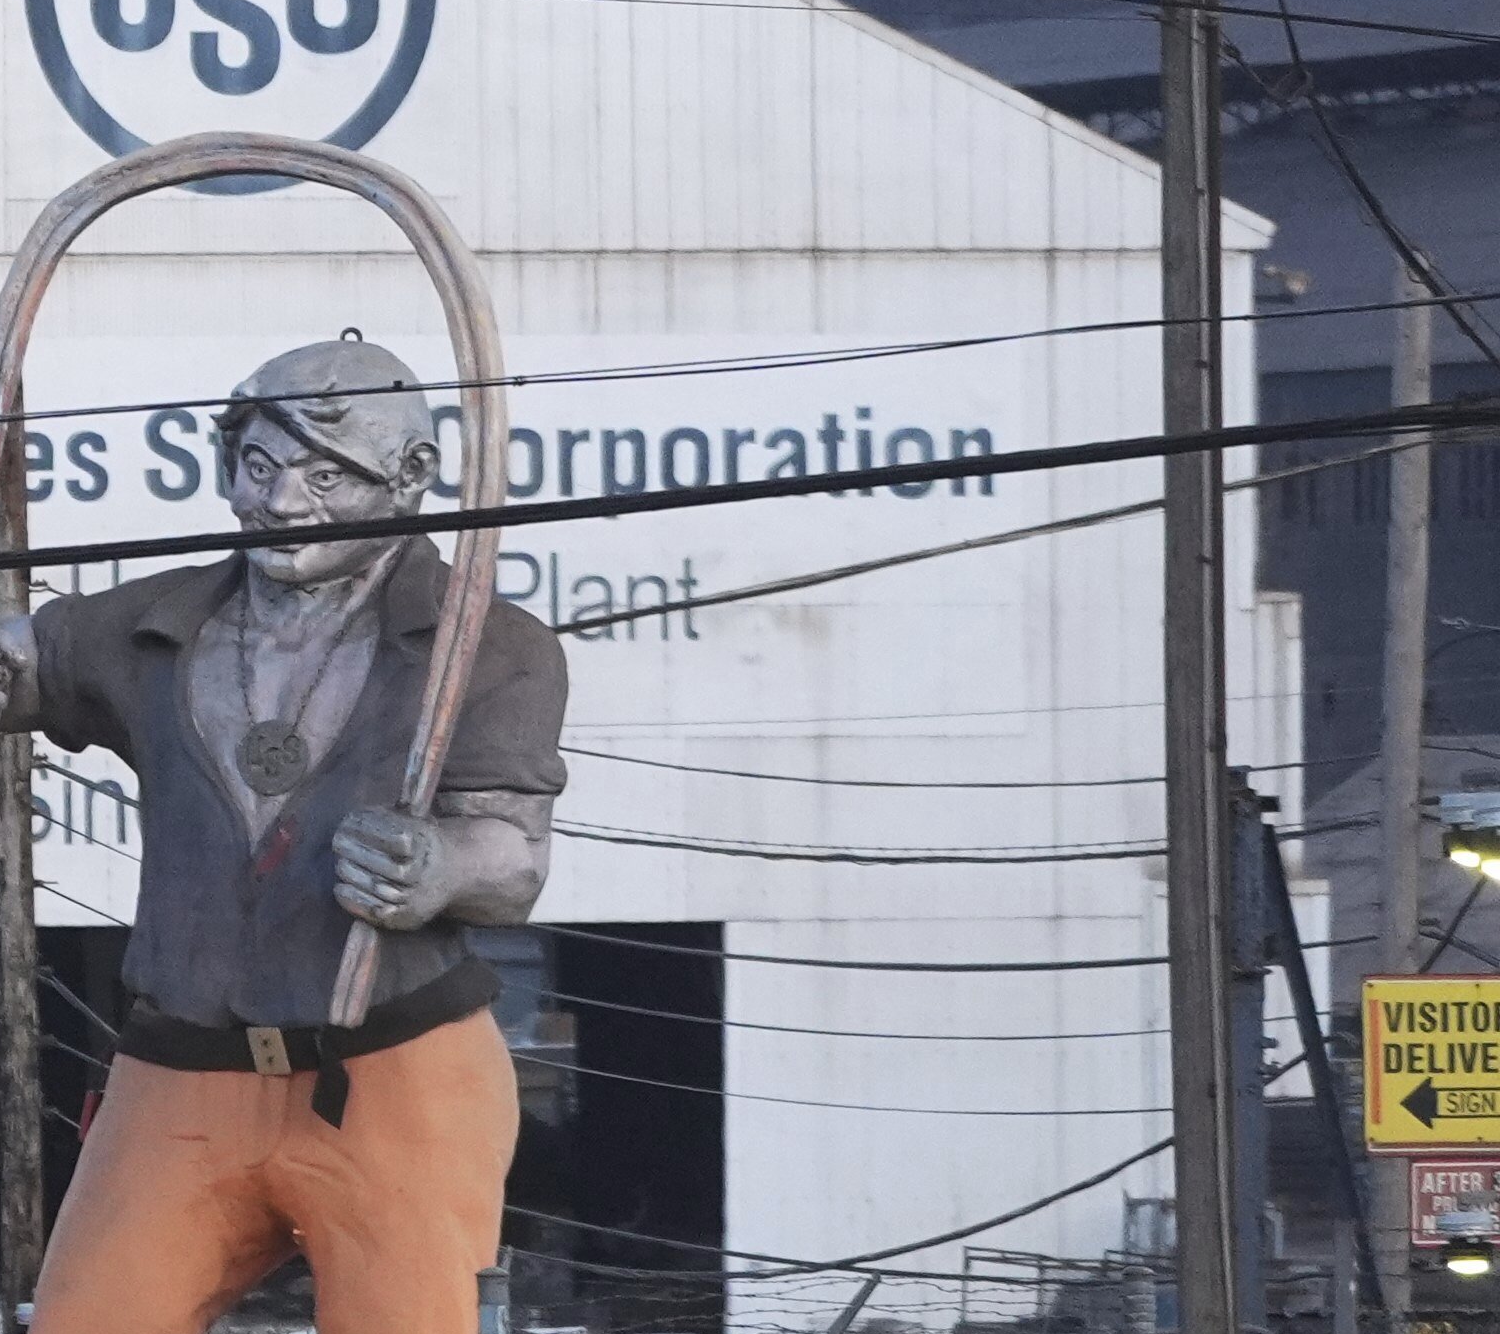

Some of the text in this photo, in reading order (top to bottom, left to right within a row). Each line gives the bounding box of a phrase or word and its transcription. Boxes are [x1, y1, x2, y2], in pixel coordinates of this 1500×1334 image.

[1383, 1000, 1500, 1033] VISITO
[1446, 1091, 1497, 1114] SIGN
[1420, 1171, 1485, 1194] AFTER
